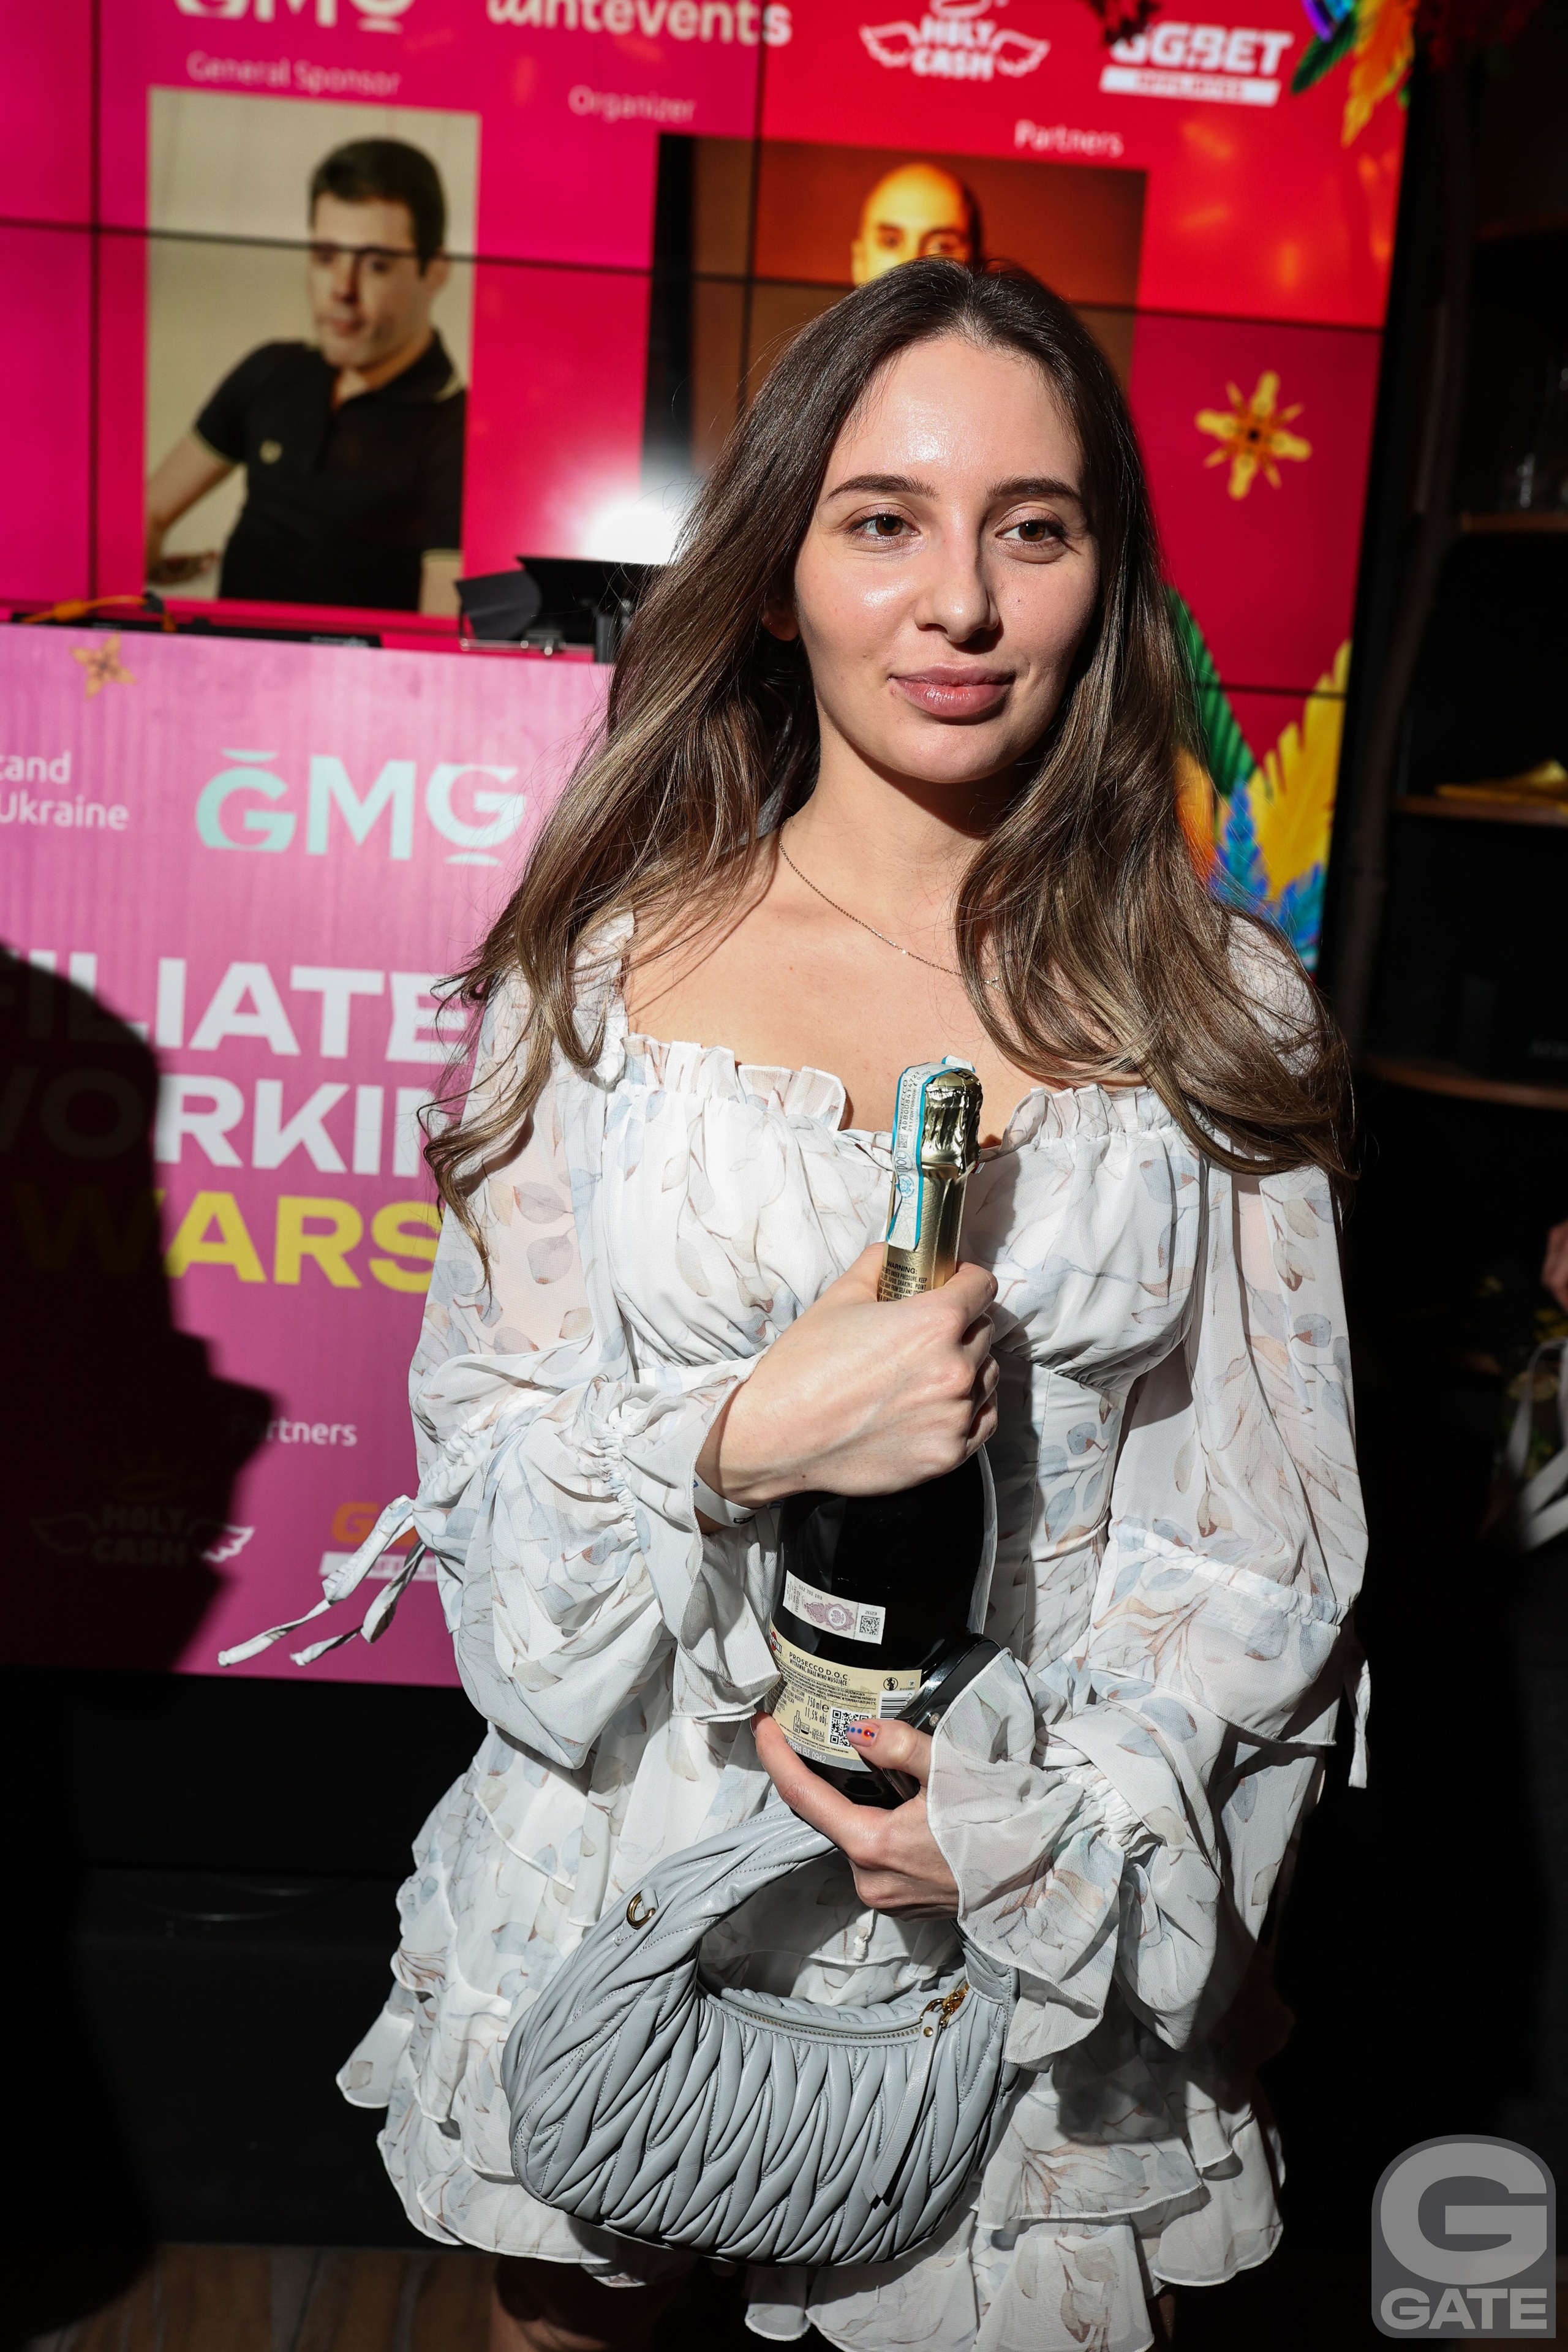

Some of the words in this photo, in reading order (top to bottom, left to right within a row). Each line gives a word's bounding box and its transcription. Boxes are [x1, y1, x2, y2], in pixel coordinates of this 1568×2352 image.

[186, 50, 291, 88] General
[293, 58, 402, 97] Sponsor
[568, 85, 696, 123] Organizer
[1014, 119, 1124, 159] Partners
[0, 749, 72, 785] and
[0, 789, 129, 832] Ukraine
[896, 1154, 908, 1170] DOC
[887, 1260, 918, 1274] WARNING:
[790, 1652, 824, 1673] PROSECCO
[826, 1669, 850, 1681] D.O.C.
[827, 1676, 848, 1686] MUSUJĄCE
[805, 1707, 818, 1721] 11,5%
[819, 1713, 828, 1727] obj.
[816, 1700, 822, 1710] ml
